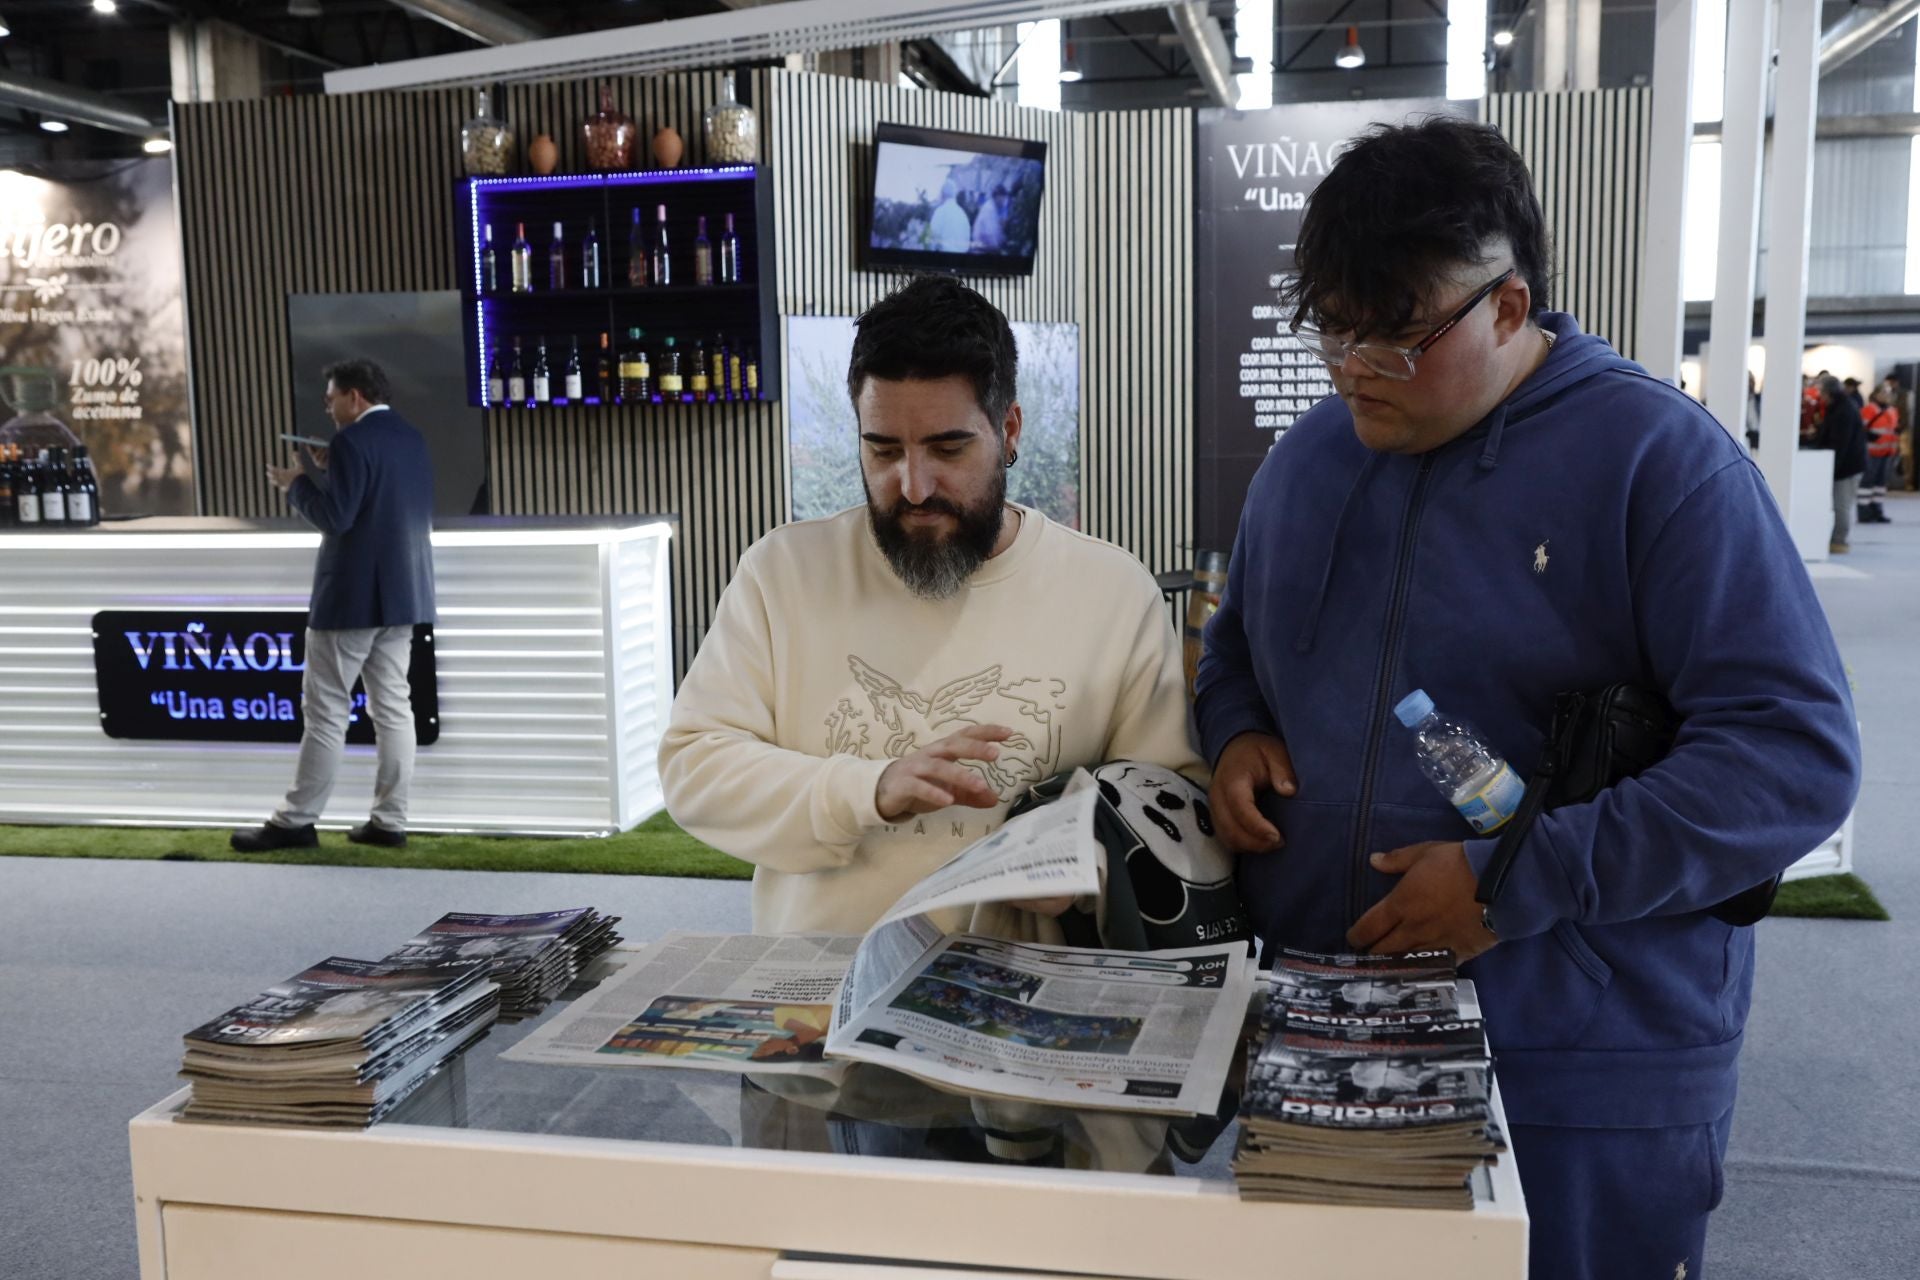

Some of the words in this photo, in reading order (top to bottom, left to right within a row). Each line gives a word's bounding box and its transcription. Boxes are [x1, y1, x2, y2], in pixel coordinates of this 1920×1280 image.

[68, 358, 142, 386] 100%
[232, 692, 295, 720] sola
[1404, 950, 1449, 960] HOY
[437, 958, 484, 968] HOY
[1195, 960, 1227, 972] HOY
[1427, 1022, 1480, 1033] HOY
